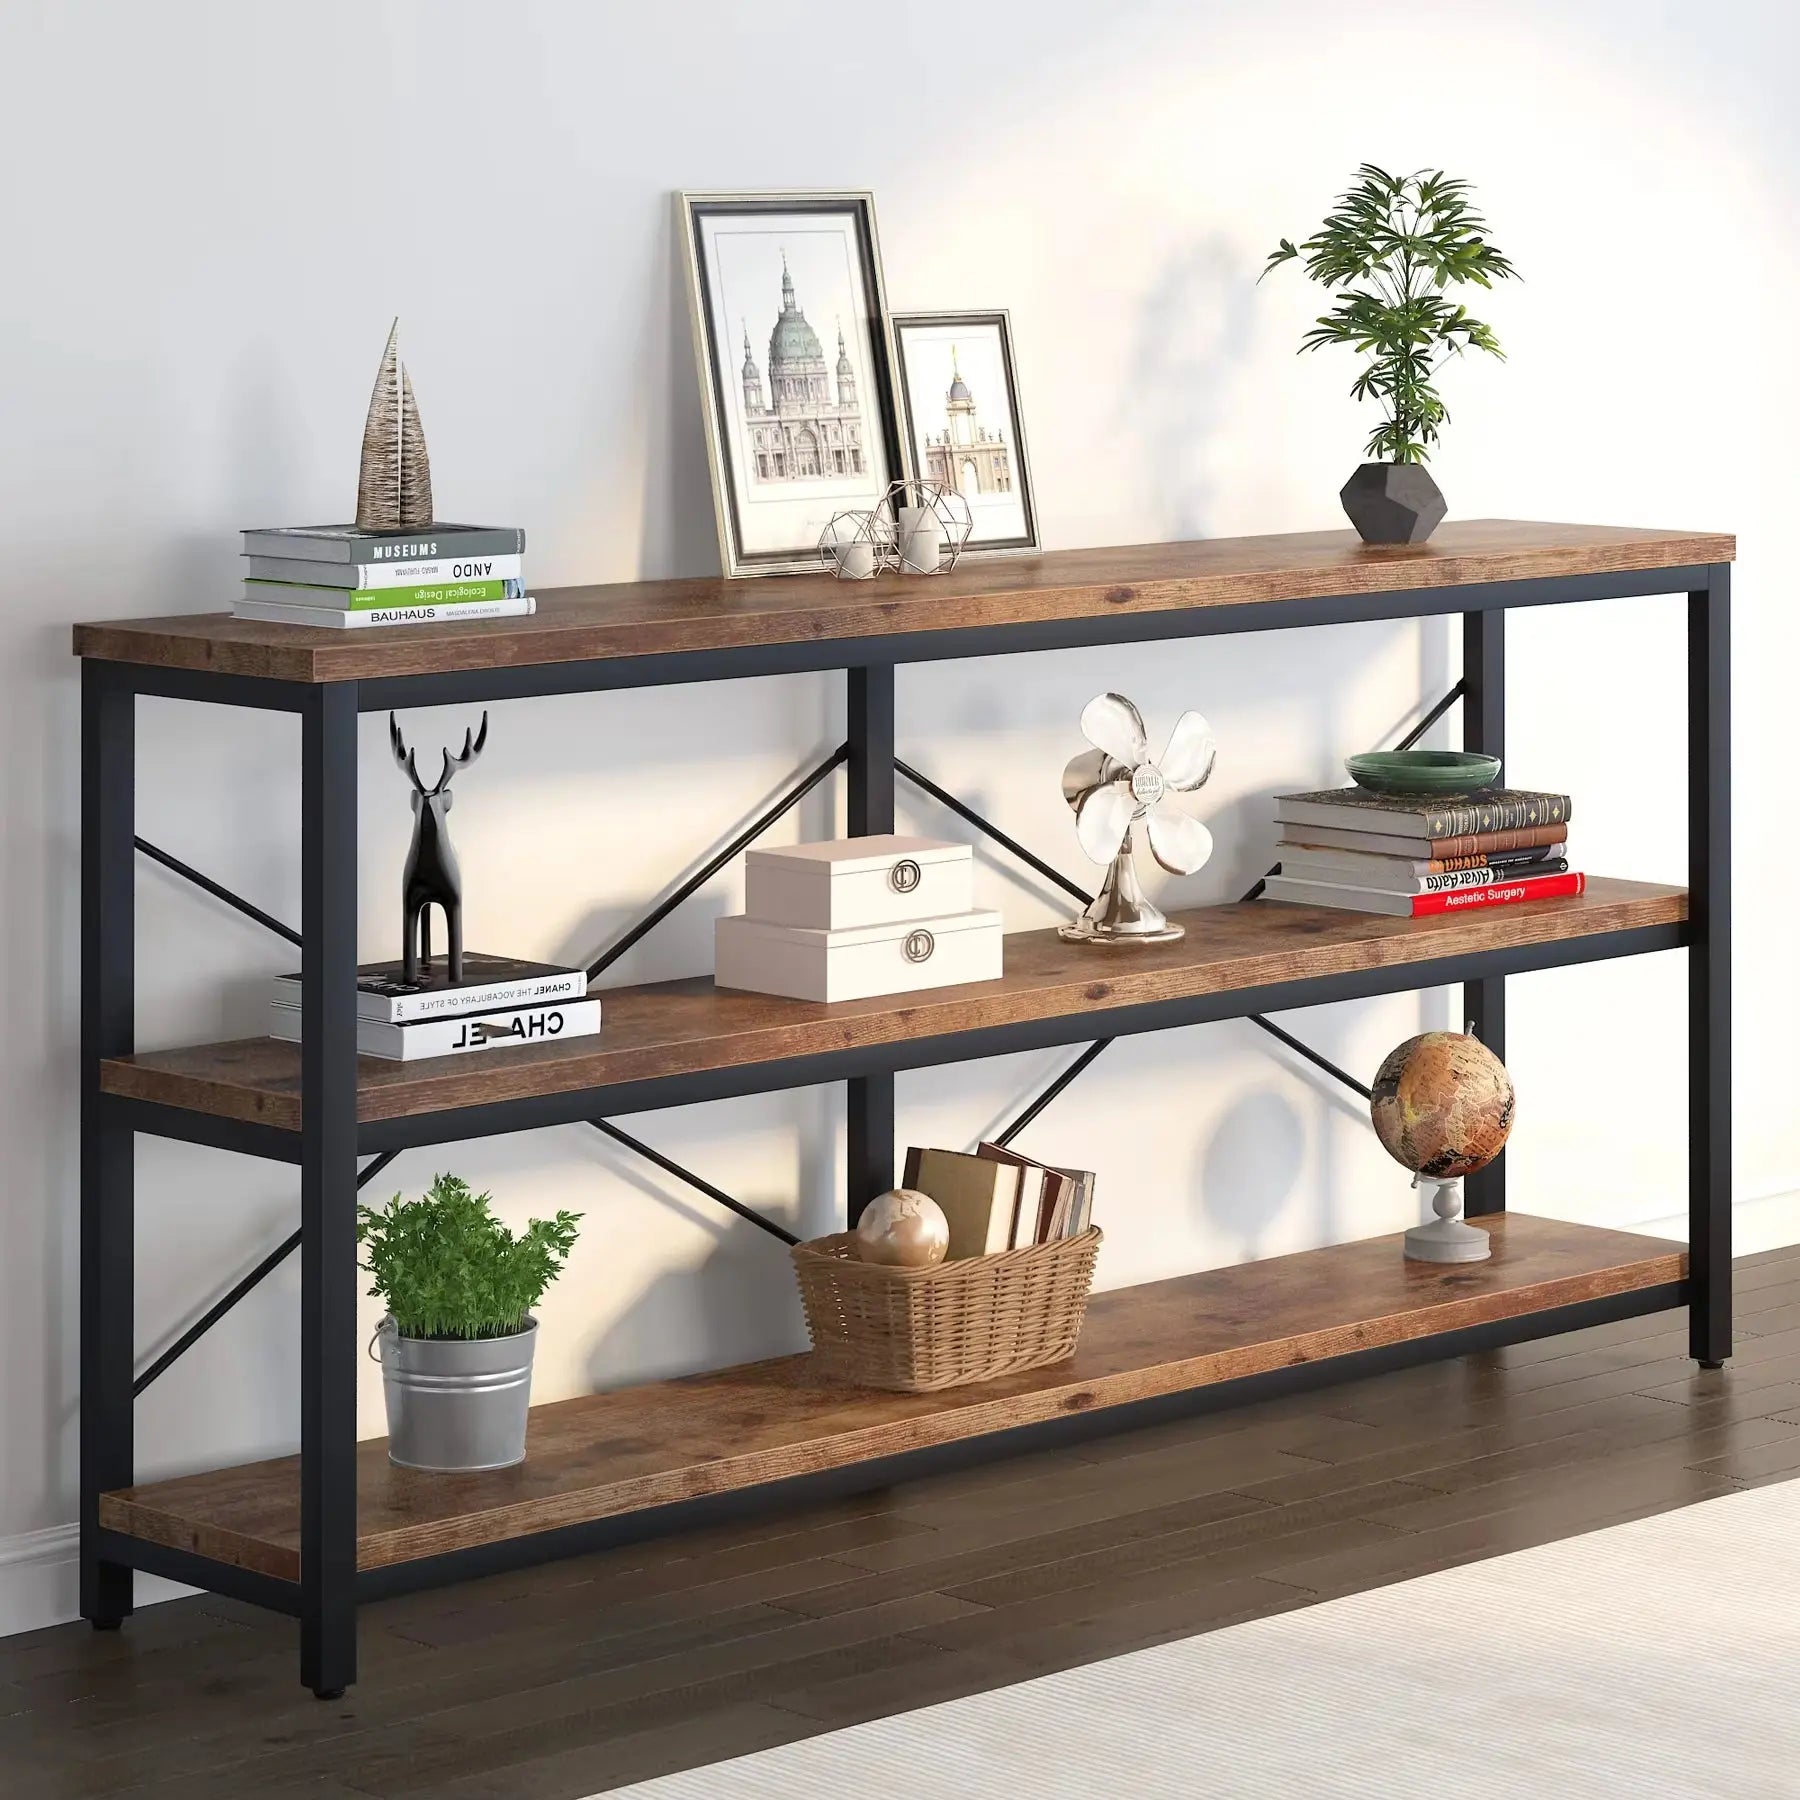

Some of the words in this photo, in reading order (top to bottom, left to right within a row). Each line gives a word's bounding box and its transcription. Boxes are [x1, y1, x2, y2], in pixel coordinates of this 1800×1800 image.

[373, 542, 437, 559] MUSEUMS
[453, 562, 492, 578] ANDO
[414, 588, 443, 600] Design
[445, 586, 487, 598] Ecological
[371, 608, 436, 622] BAUHAUS
[1426, 873, 1458, 891] Aalto
[1459, 869, 1490, 886] Alvar
[1445, 891, 1485, 907] Aestetic
[1487, 886, 1526, 901] Surgery
